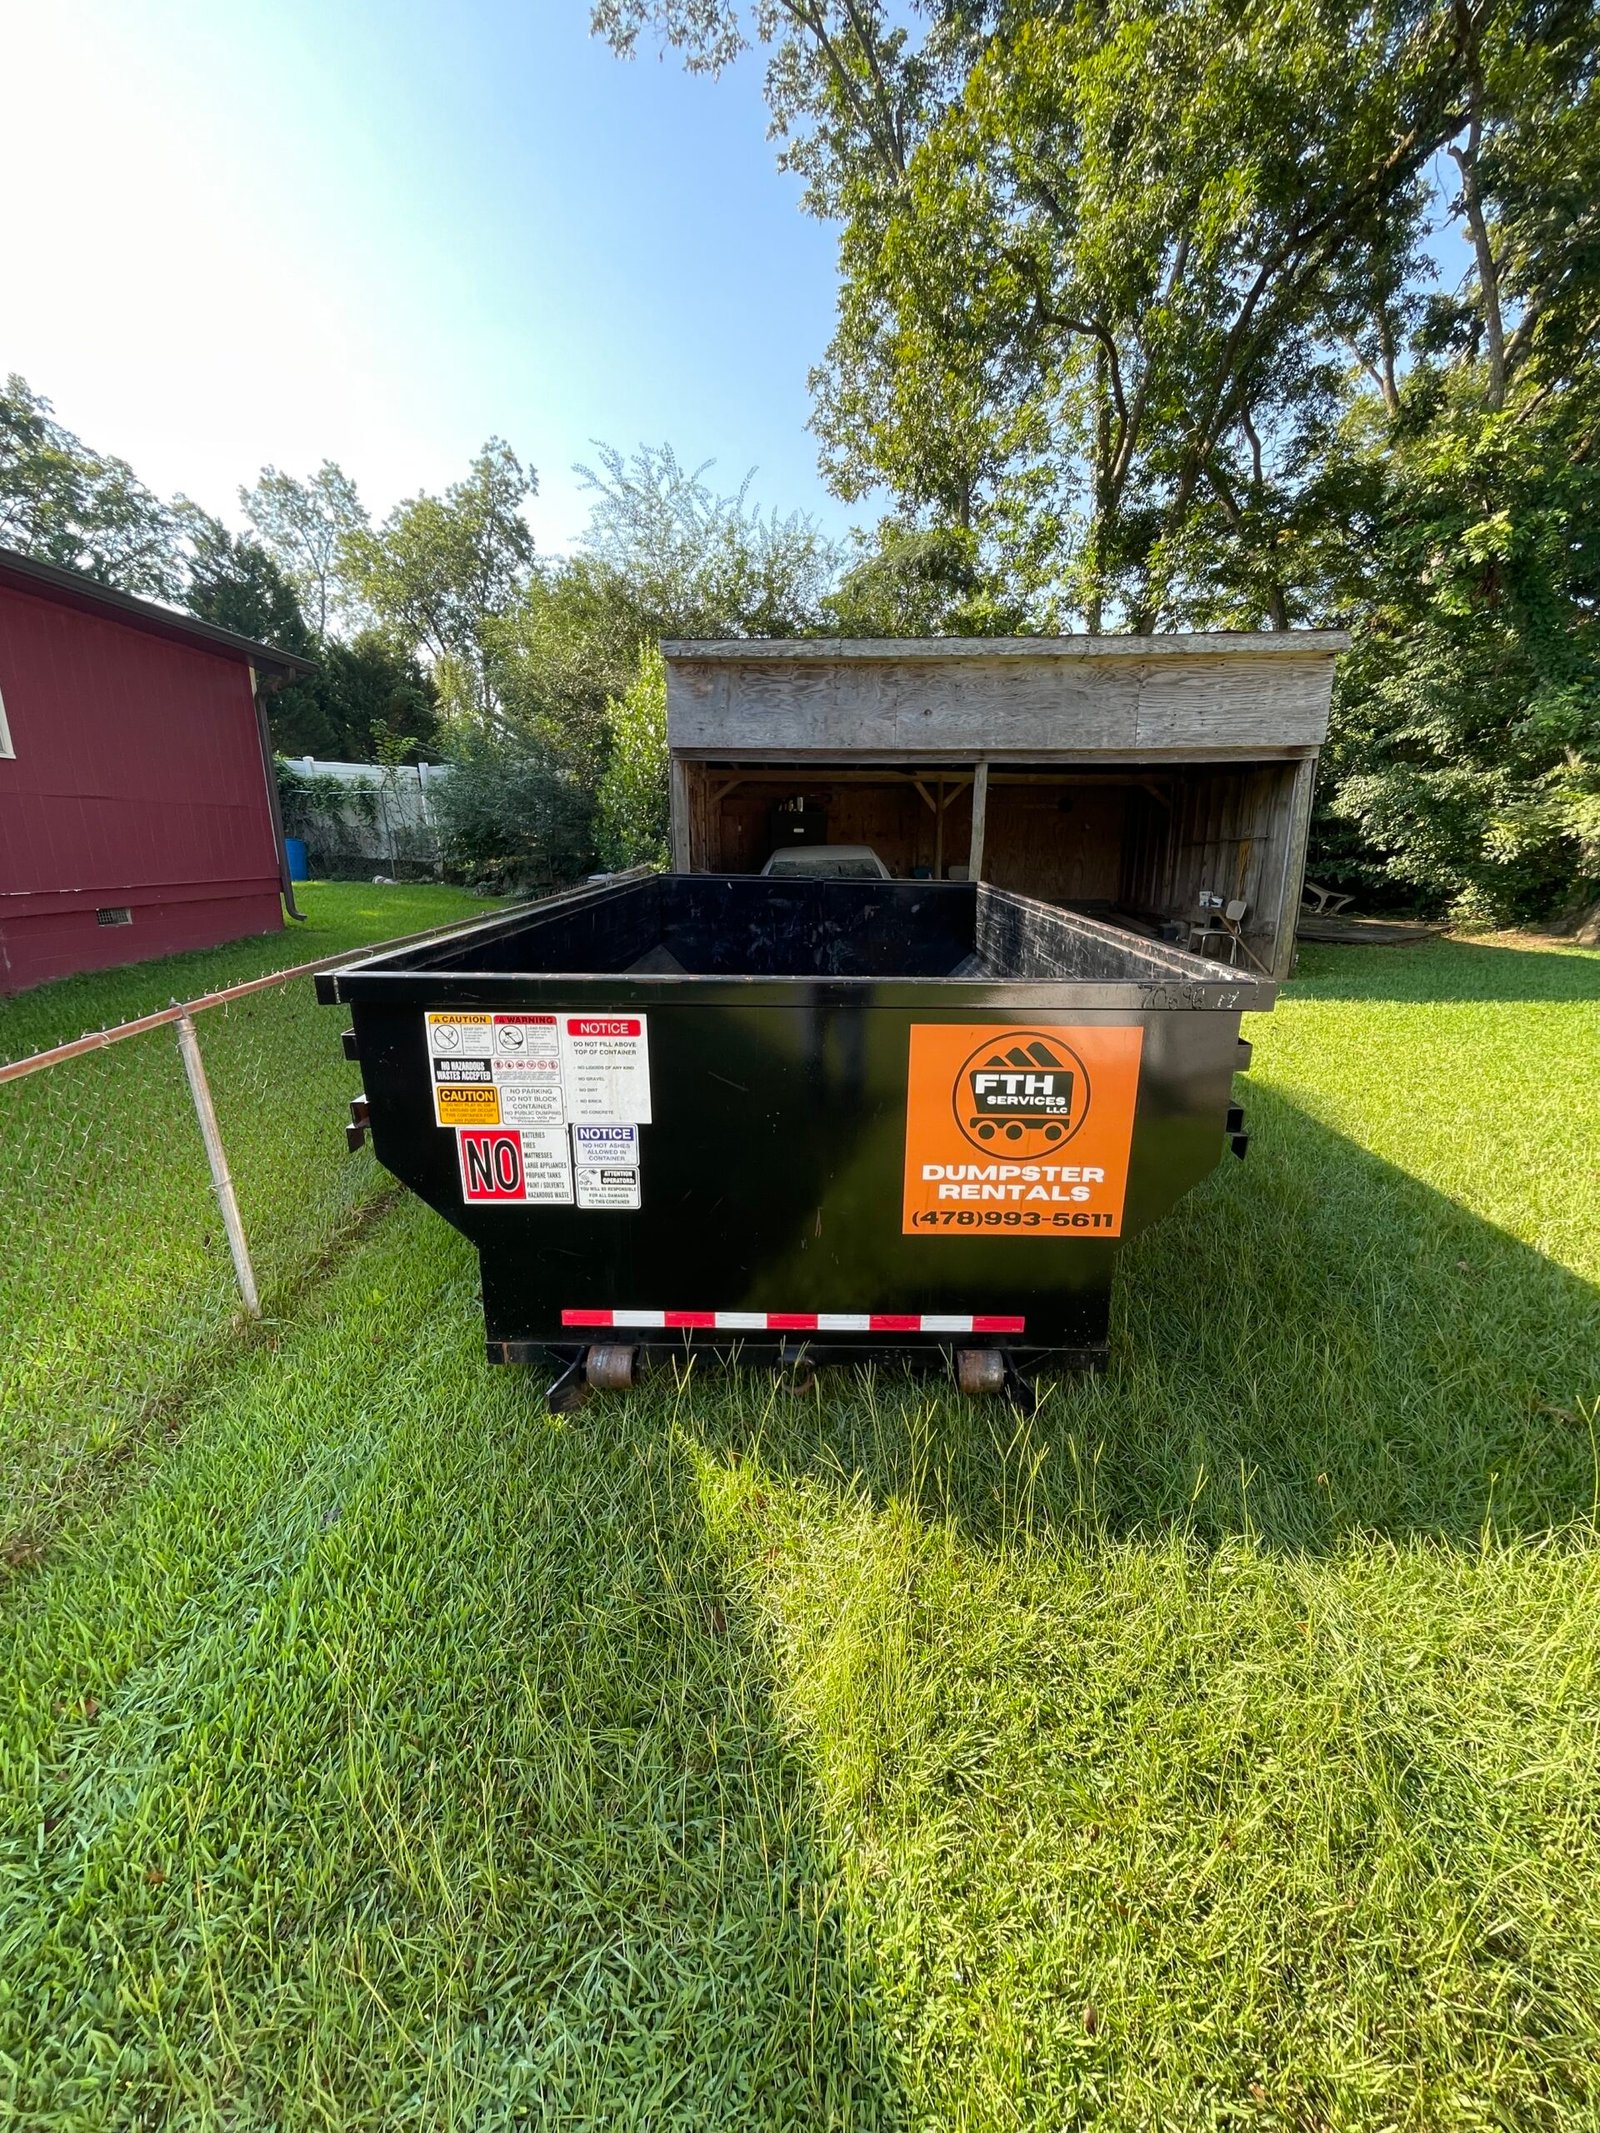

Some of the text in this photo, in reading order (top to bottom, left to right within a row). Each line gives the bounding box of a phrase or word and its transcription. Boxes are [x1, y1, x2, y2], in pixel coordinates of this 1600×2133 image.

[580, 1023, 629, 1034] NOTICE
[440, 1061, 486, 1071] NO HAZARDOUS
[436, 1071, 461, 1081] WASTES
[461, 1071, 491, 1081] ACCEPTED
[975, 1074, 1054, 1095] FTH
[441, 1090, 494, 1102] CAUTION
[986, 1095, 1066, 1106] SERVICES
[1046, 1106, 1068, 1114] LLC
[580, 1128, 632, 1140] NOTICE
[465, 1137, 520, 1192] NO
[922, 1165, 1105, 1183] DUMPSTER
[938, 1184, 1091, 1201] RENTALS
[912, 1210, 1113, 1227] (478)993-5611
